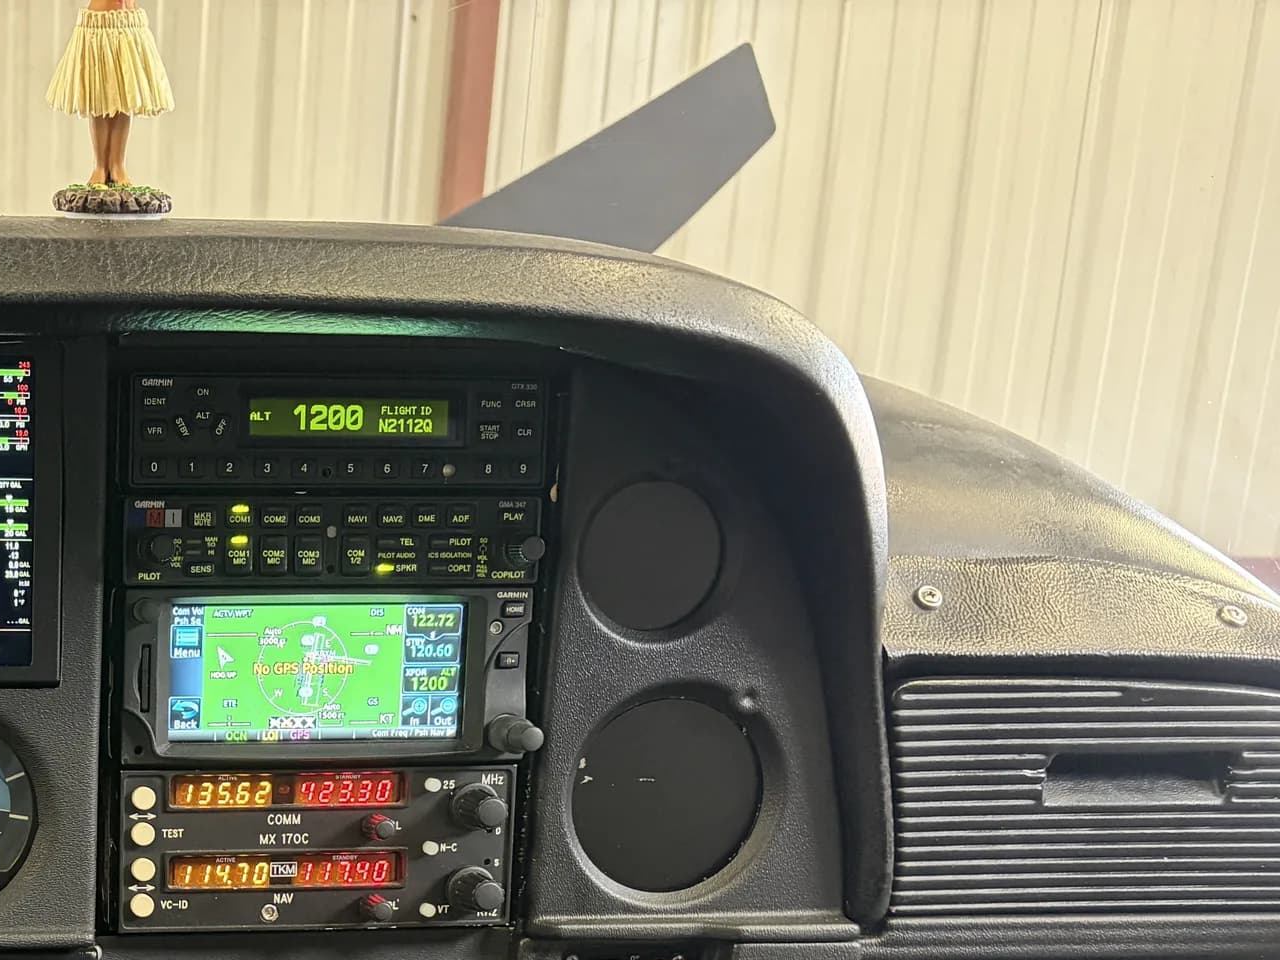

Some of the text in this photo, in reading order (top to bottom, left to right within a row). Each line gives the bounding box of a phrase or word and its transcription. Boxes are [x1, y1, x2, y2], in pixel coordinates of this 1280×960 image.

[249, 412, 271, 420] ALT
[381, 406, 432, 415] FLIGHT ID
[294, 404, 363, 431] 1200
[379, 419, 432, 433] N2112Q
[348, 515, 367, 523] NAV1
[452, 515, 470, 523] ADF
[503, 513, 524, 521] PLAY
[412, 614, 454, 627] 122.72
[174, 648, 200, 657] Menu
[410, 644, 452, 657] 120.60
[253, 663, 353, 675] No GPS Position
[411, 677, 448, 691] 1200
[174, 719, 197, 729] Back
[184, 781, 271, 805] 135.62
[267, 814, 301, 825] COMM
[162, 829, 184, 838] TEST
[259, 833, 309, 845] MX 170C
[183, 862, 269, 885] 114.70
[271, 863, 297, 876] TKM
[304, 860, 390, 882] 117.40
[274, 893, 294, 904] NAV
[160, 900, 188, 910] VC-ID
